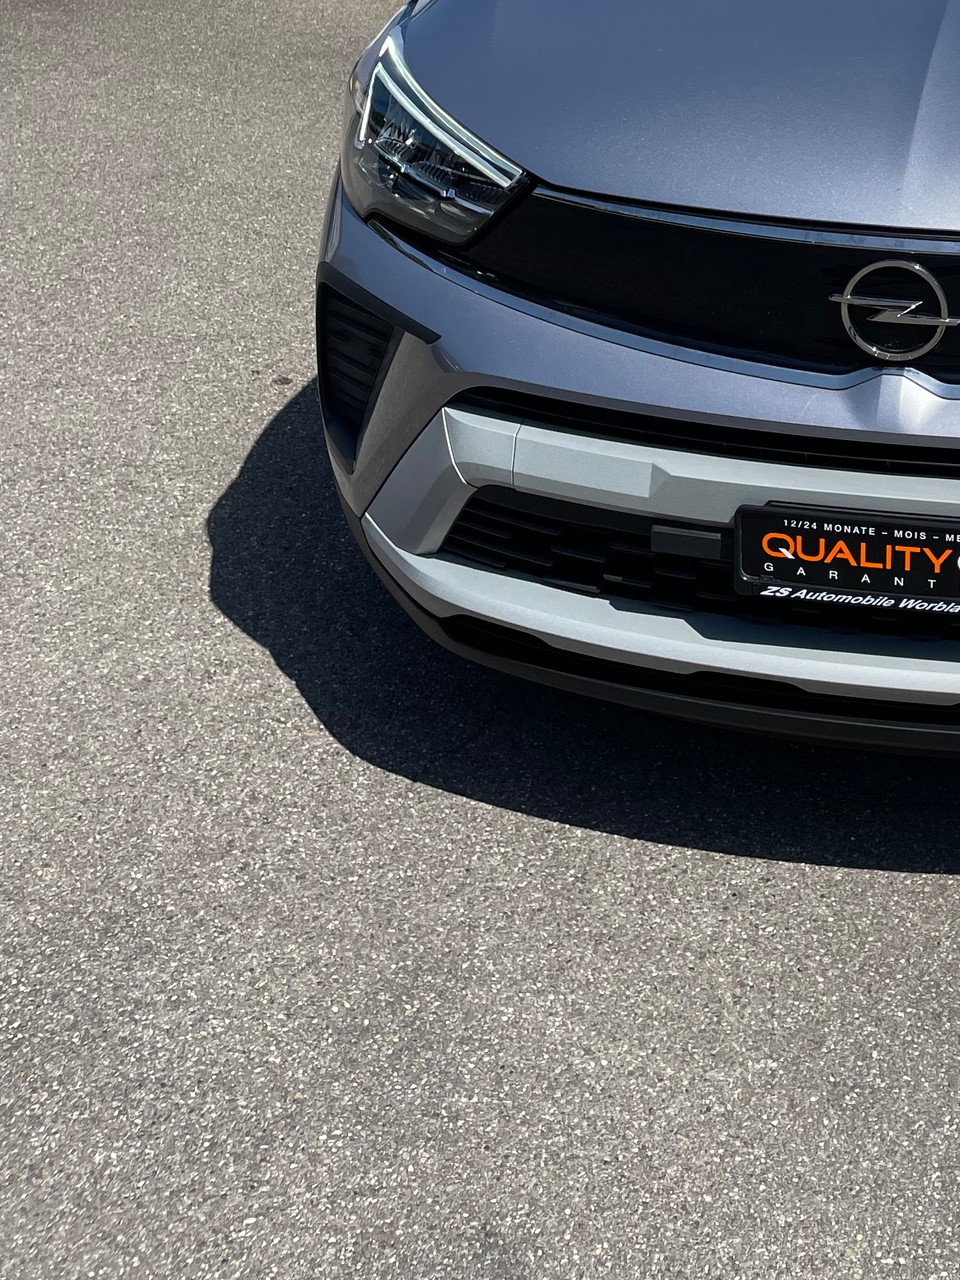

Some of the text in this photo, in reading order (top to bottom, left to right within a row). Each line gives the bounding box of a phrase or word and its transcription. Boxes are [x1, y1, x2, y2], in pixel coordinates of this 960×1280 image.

[783, 519, 818, 530] 12/24
[823, 523, 876, 536] MONATE
[894, 529, 927, 540] MOIS
[761, 532, 953, 574] QUALITY
[760, 586, 793, 597] ZS
[790, 589, 896, 608] Automobile
